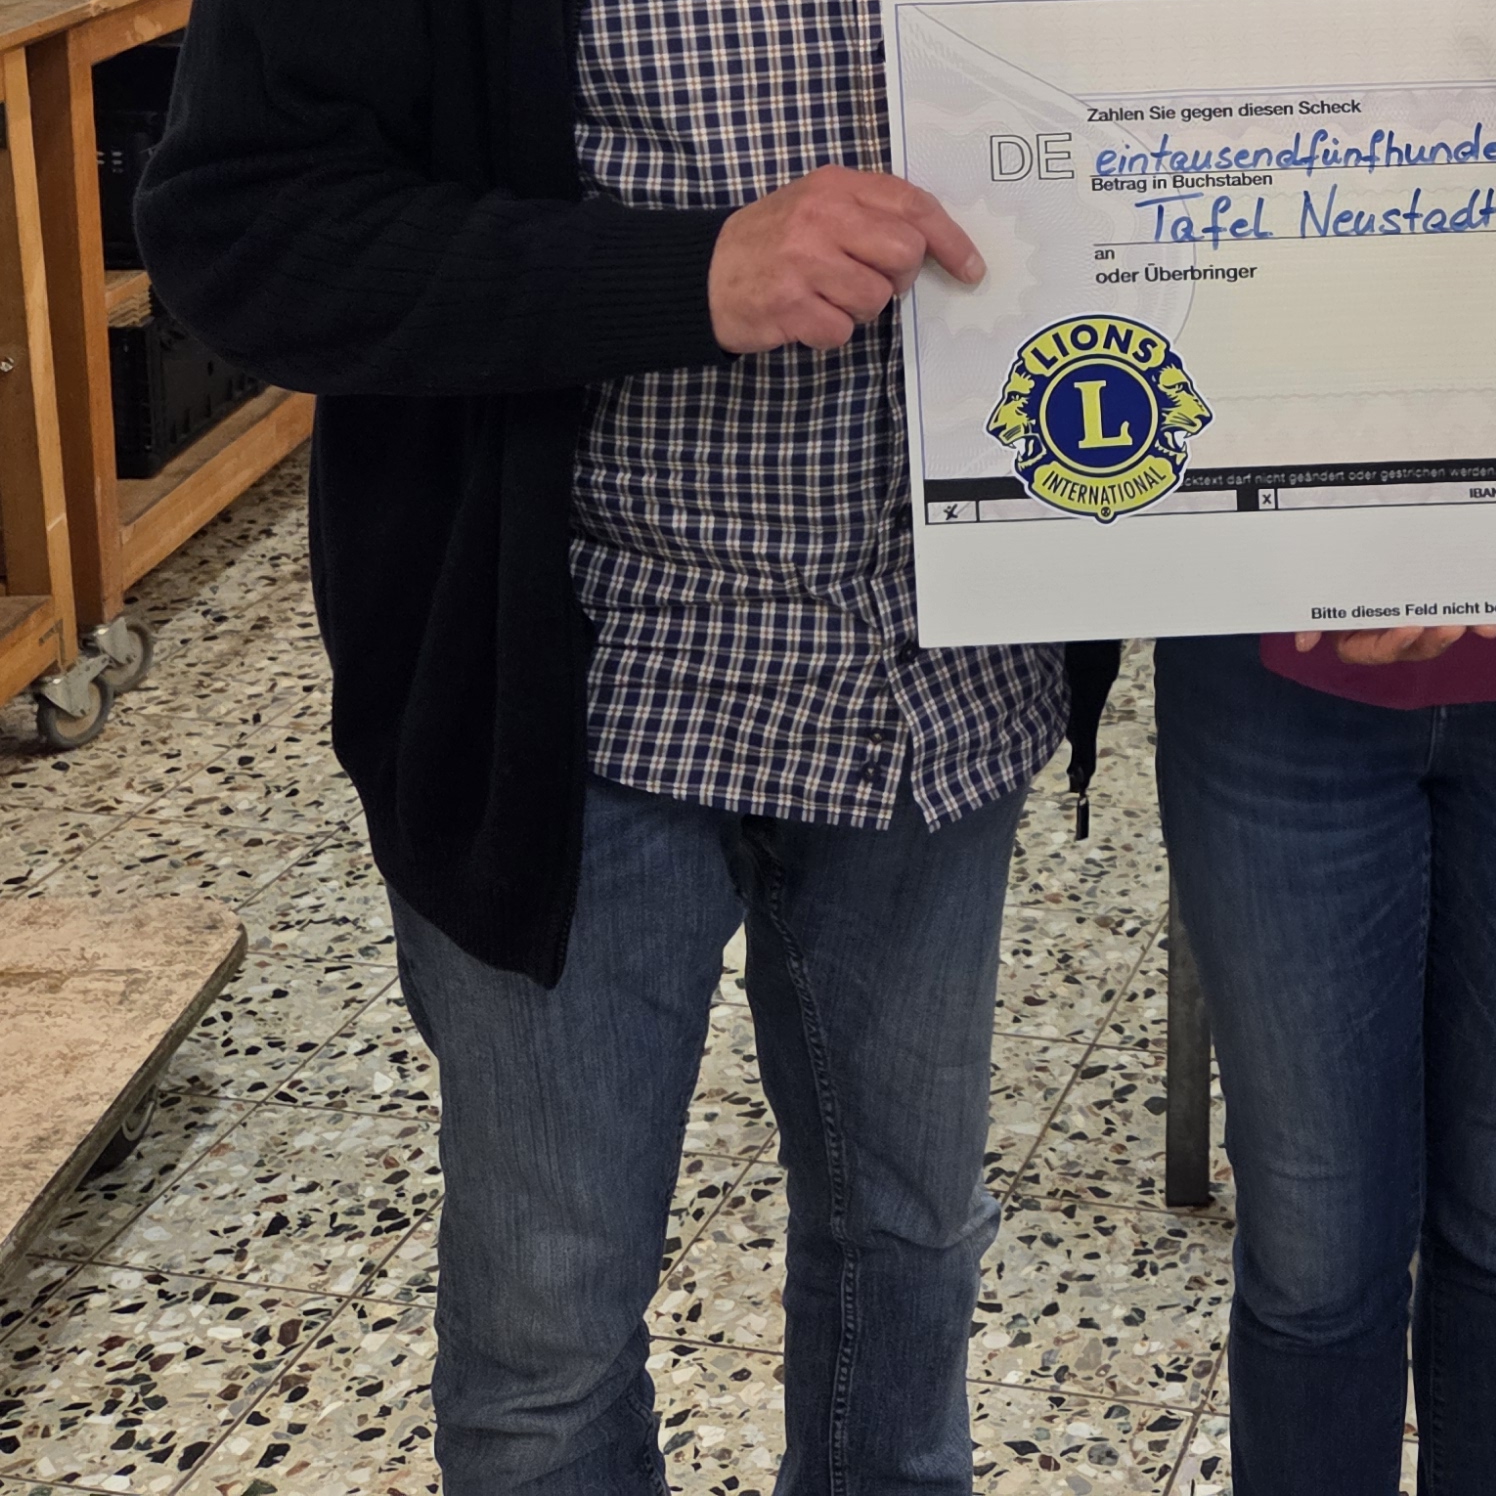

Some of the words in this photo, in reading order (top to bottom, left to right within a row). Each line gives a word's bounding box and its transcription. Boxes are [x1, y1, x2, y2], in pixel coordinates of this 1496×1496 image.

[1087, 107, 1144, 123] Zahlen
[1149, 106, 1176, 120] Sie
[1181, 107, 1233, 122] gegen
[1238, 103, 1293, 117] diesen
[1298, 100, 1361, 115] Scheck
[989, 132, 1075, 182] DE
[1091, 178, 1147, 192] Betrag
[1152, 176, 1167, 189] in
[1172, 173, 1273, 189] Buchstaben
[1135, 192, 1273, 251] Tafel
[1094, 248, 1115, 260] an
[1095, 268, 1139, 284] oder
[1144, 262, 1258, 284] Überbringer
[1030, 324, 1158, 370] LIONS
[1073, 380, 1133, 449] L
[1042, 466, 1166, 505] INTERNATIONAL
[1181, 474, 1224, 487] cktext
[1227, 473, 1251, 485] darf
[1255, 472, 1286, 484] nicht
[1289, 471, 1345, 485] geändert
[1348, 470, 1376, 482] oder
[1380, 467, 1445, 482] gestrichen
[1311, 607, 1347, 619] Bitte
[1352, 606, 1400, 618] dieses
[1405, 603, 1438, 616] Feld
[1443, 602, 1480, 614] nicht
